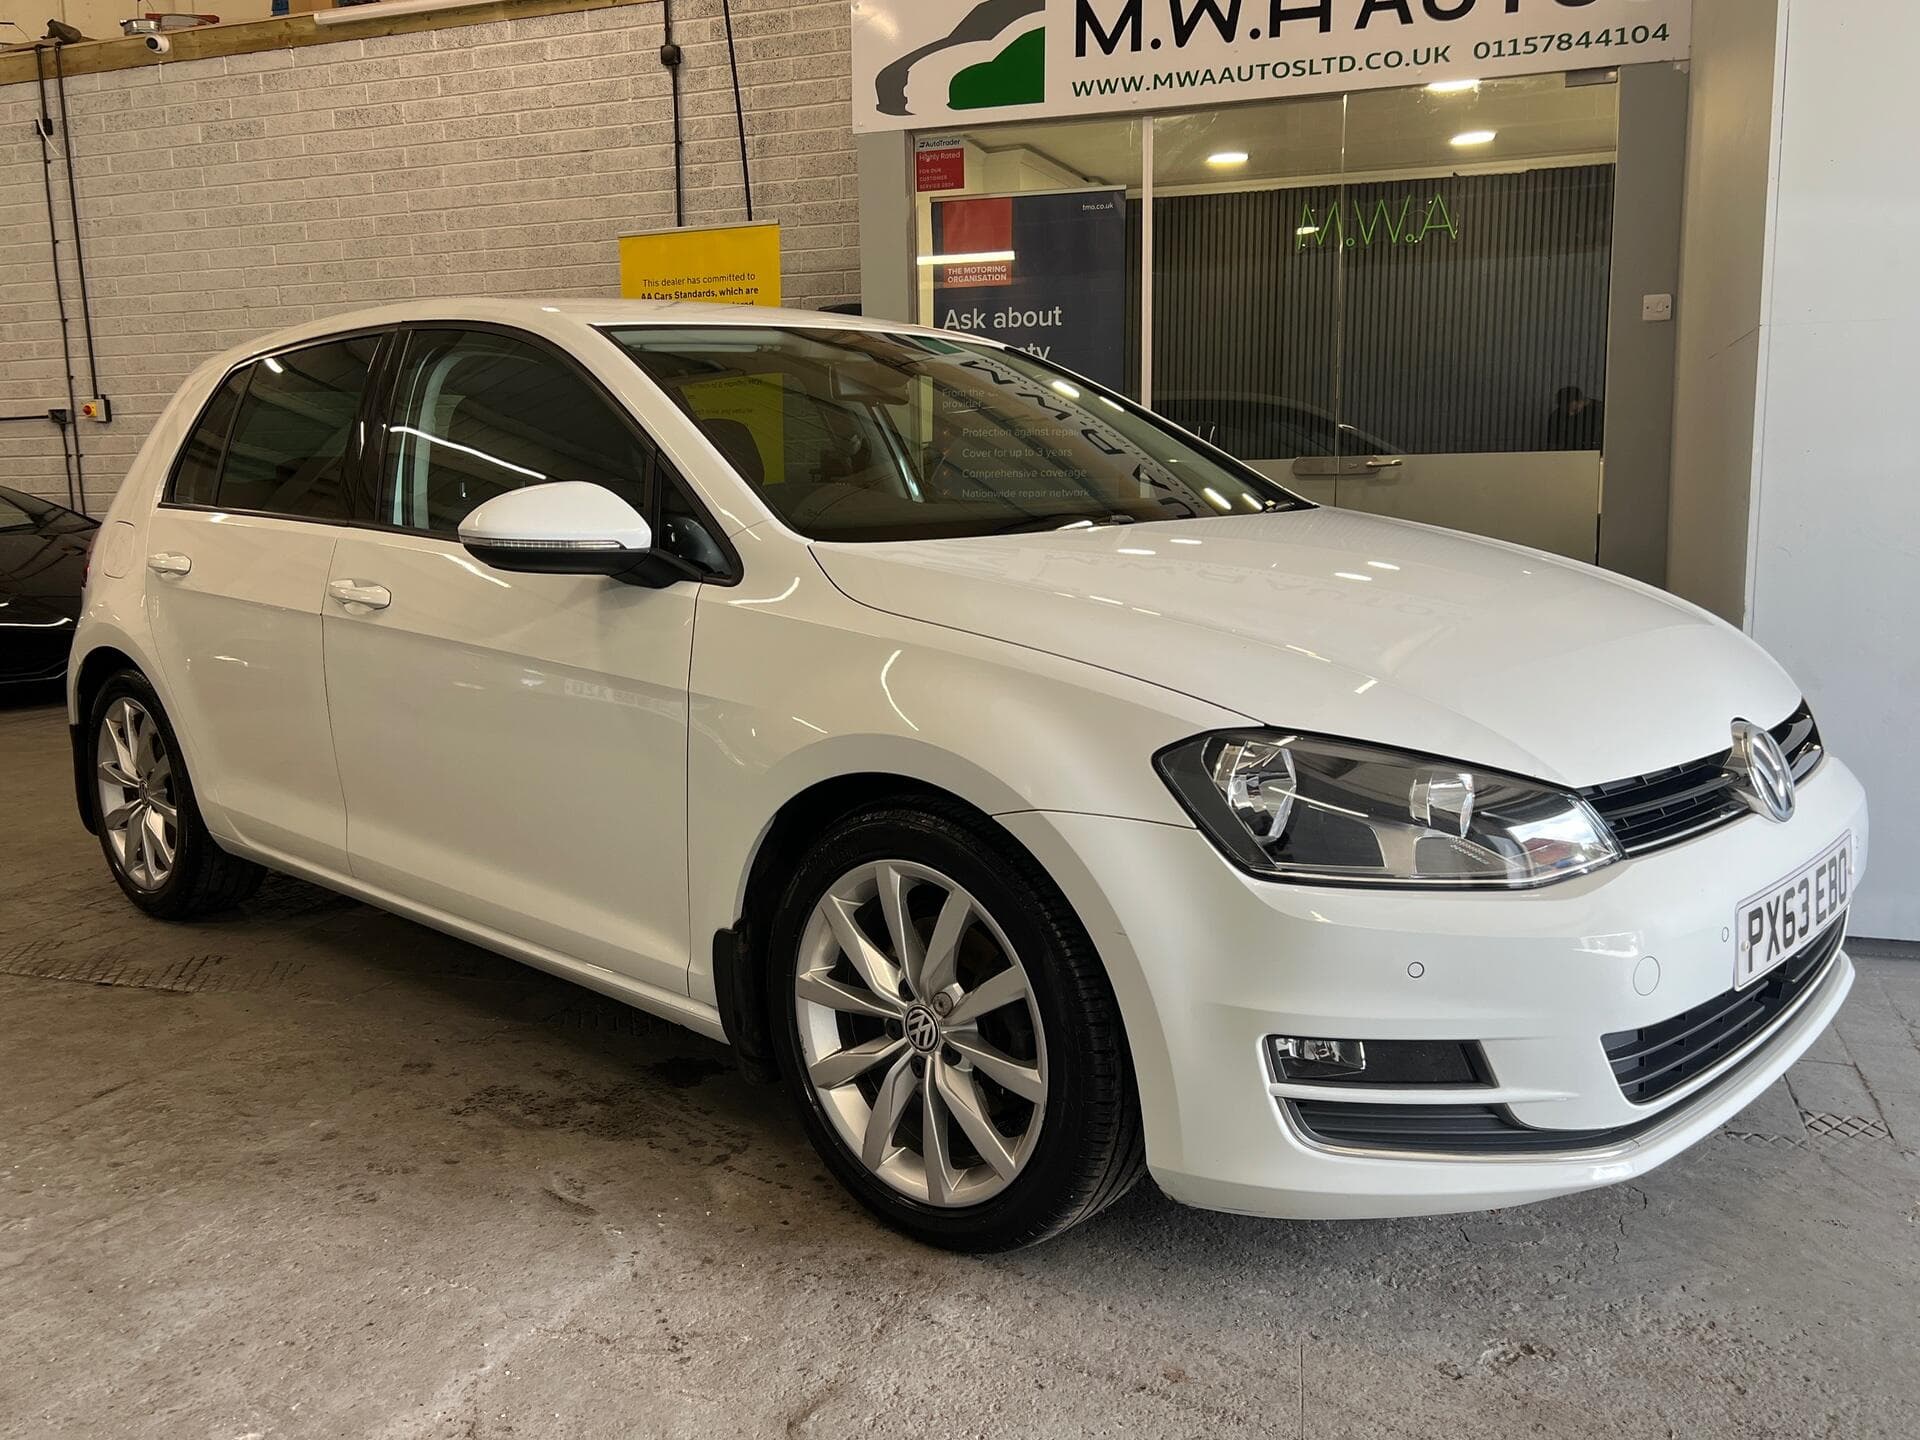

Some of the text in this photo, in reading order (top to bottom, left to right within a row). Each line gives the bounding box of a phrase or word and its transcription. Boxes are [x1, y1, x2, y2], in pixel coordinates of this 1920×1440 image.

[1072, 23, 1670, 97] WWW.MWAAUTOSLTD.CO.UK 01157844104
[1082, 202, 1113, 211] tmo.co.uk
[1297, 193, 1456, 250] M.W.A
[948, 265, 1007, 276] THE MOTORING
[643, 273, 756, 288] This dealer has committed to
[947, 273, 1007, 283] ORGANISATION
[641, 287, 759, 300] AA Cars Standards, which are
[943, 306, 1063, 330] Ask about
[969, 389, 984, 397] the
[943, 400, 981, 411] provider
[962, 427, 1011, 438] Protection
[1015, 428, 1050, 438] against
[962, 448, 1073, 459] Cover for up to 3 years
[962, 468, 1087, 480] Comprehensive coverage
[962, 488, 1089, 499] Nationwide repair network
[1748, 847, 1847, 974] PX63 EBO
